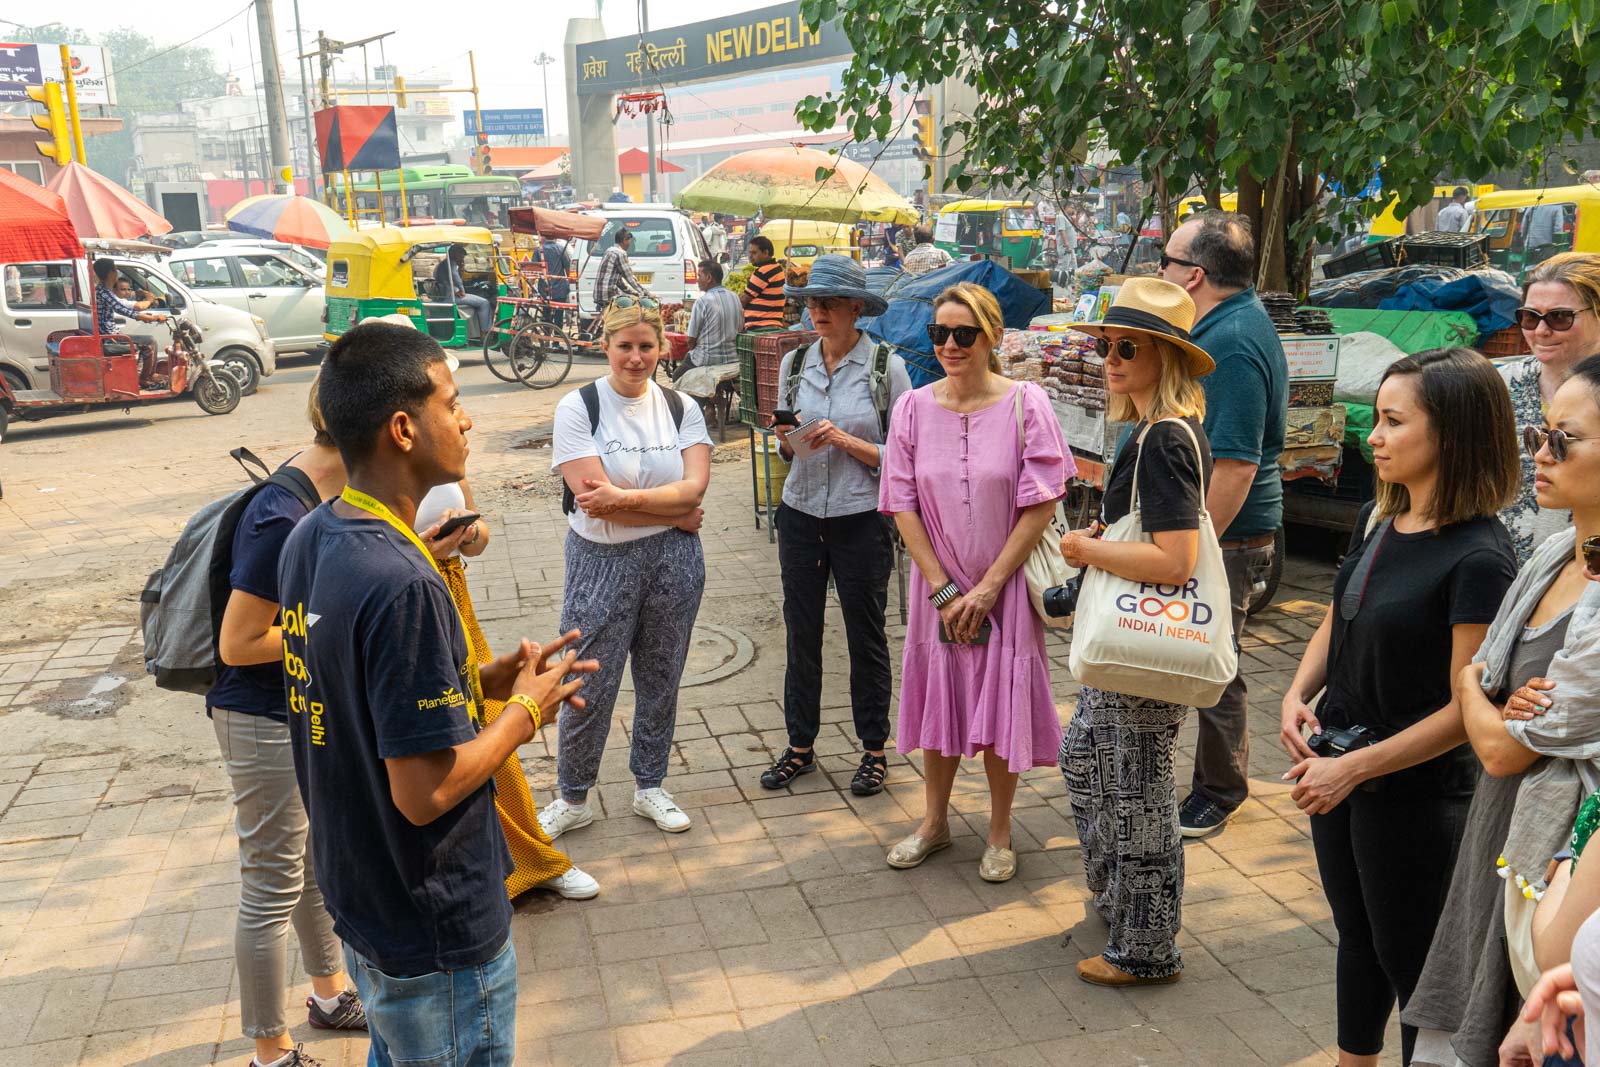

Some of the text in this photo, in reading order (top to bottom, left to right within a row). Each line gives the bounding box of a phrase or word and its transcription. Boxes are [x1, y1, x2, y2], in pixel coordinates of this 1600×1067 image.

[706, 24, 753, 65] NEW
[1118, 616, 1157, 635] INDIA
[1165, 625, 1211, 645] NEPAL
[310, 701, 326, 747] Delhi
